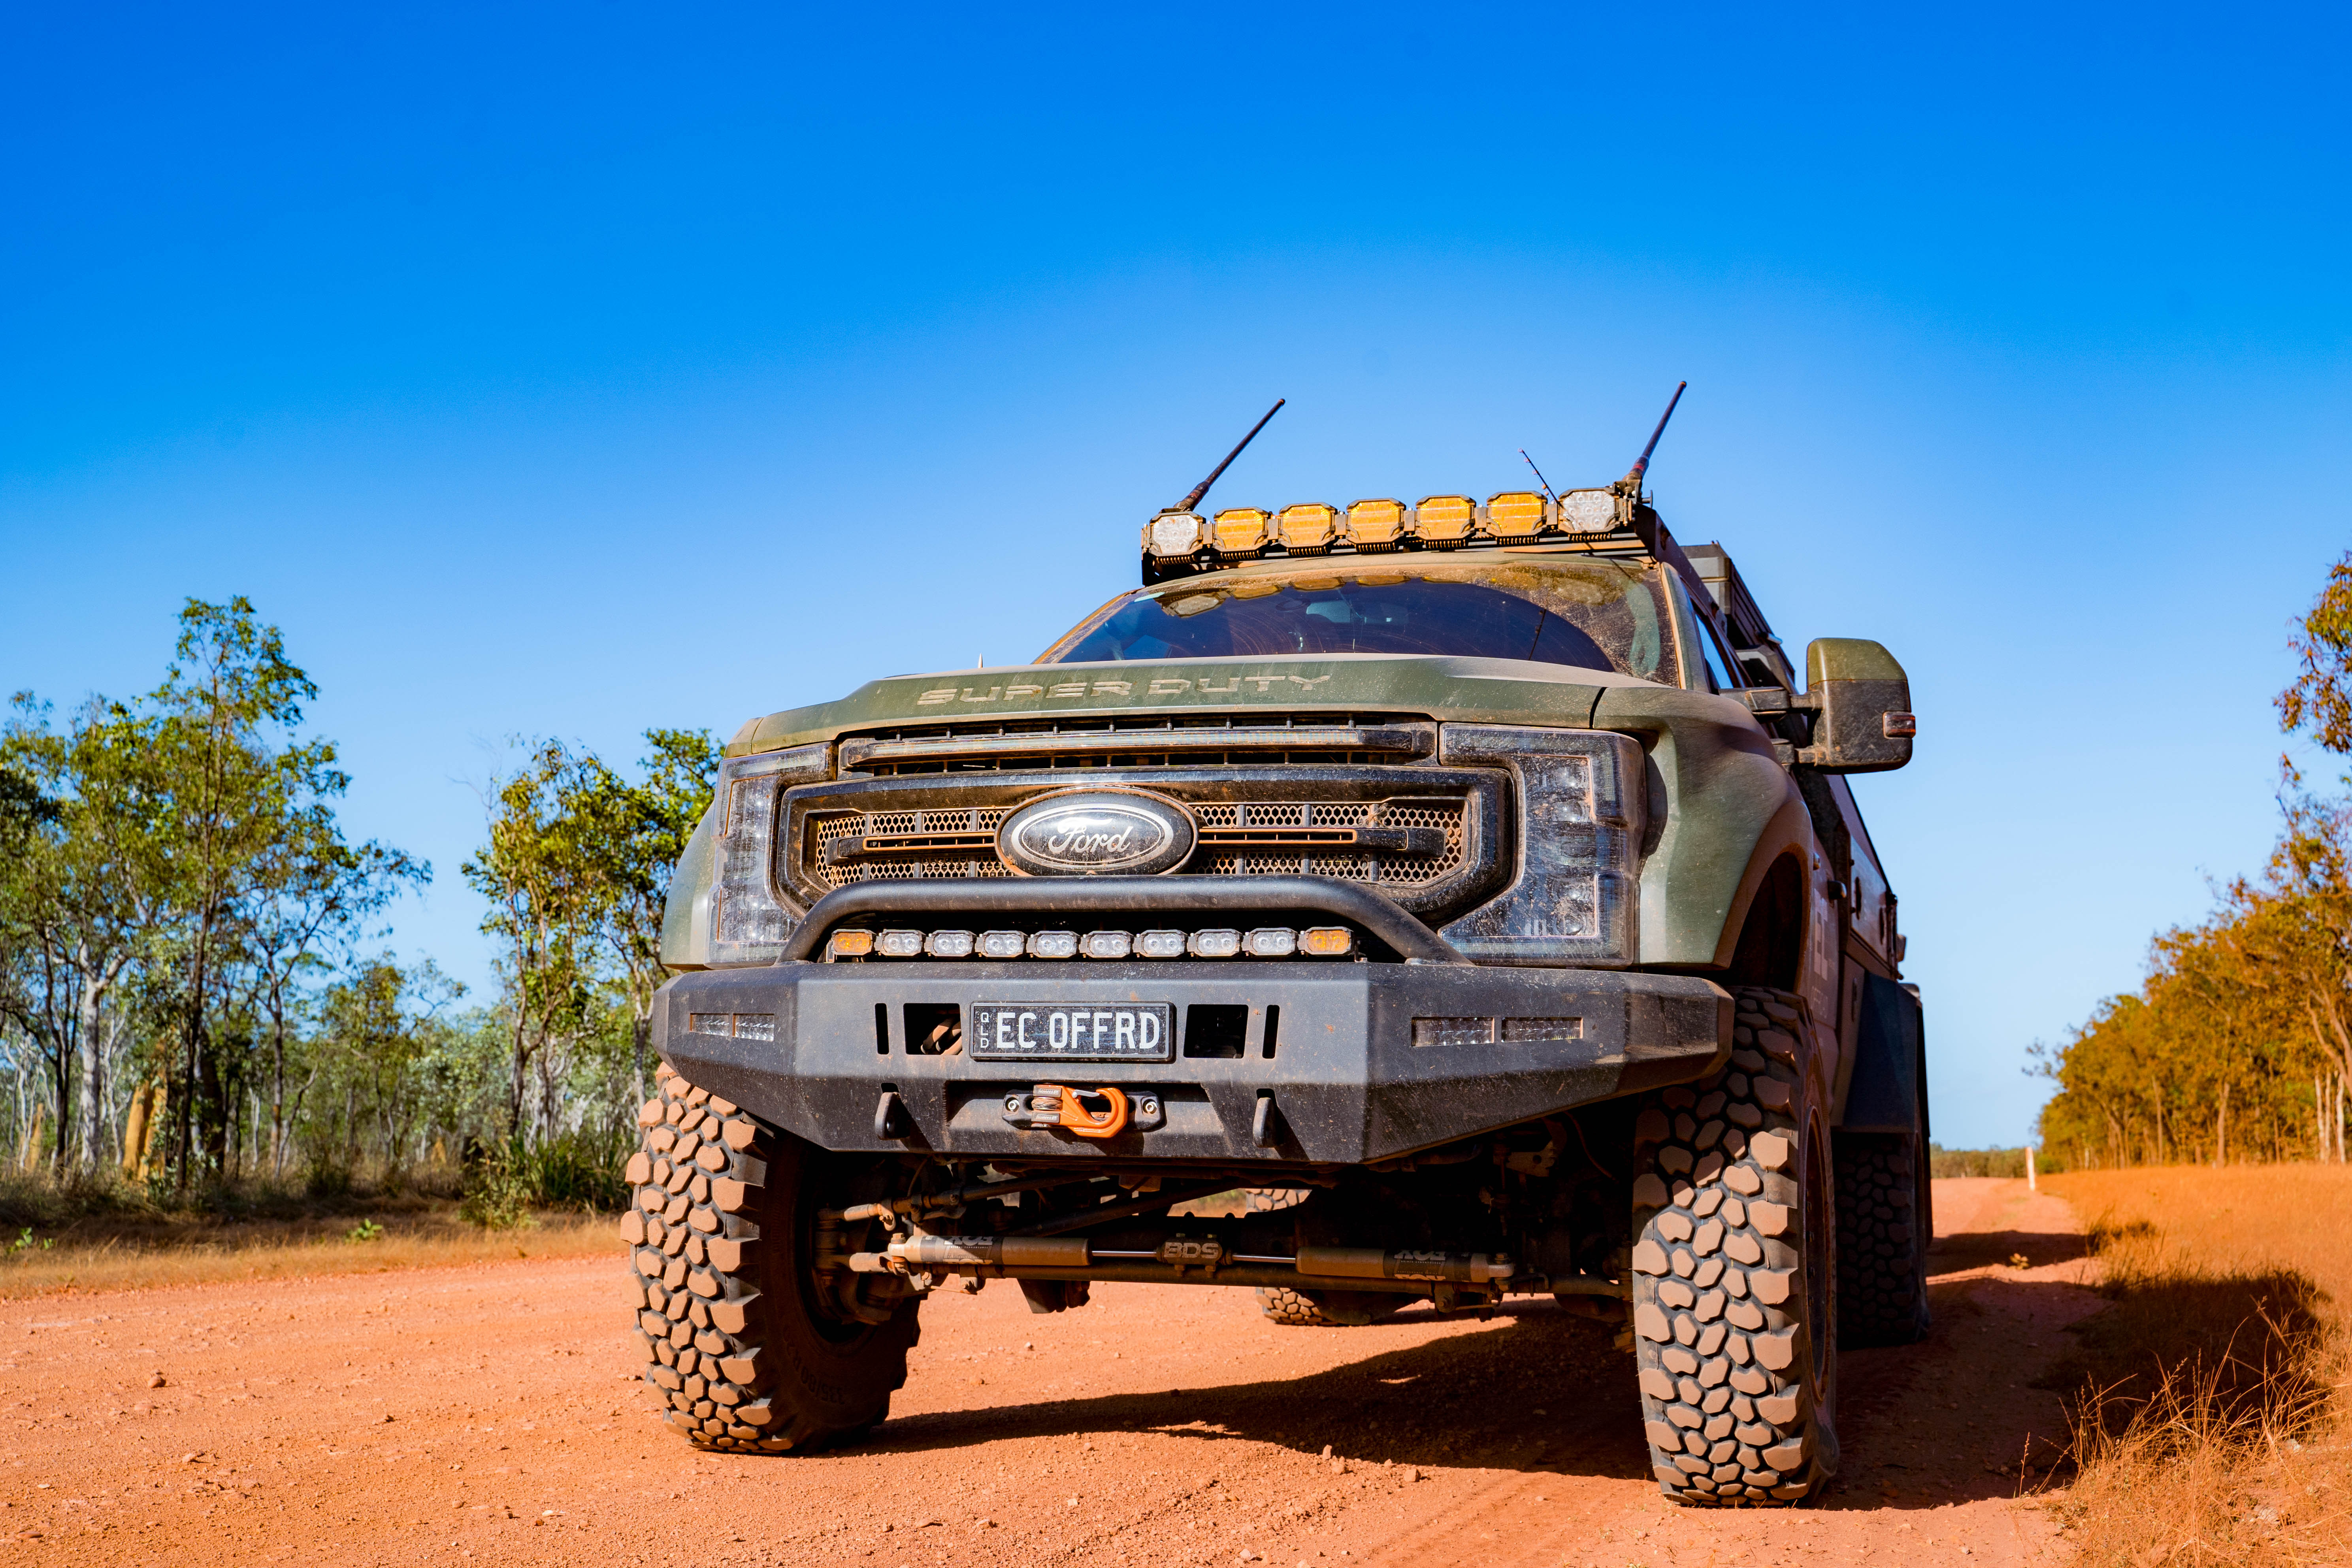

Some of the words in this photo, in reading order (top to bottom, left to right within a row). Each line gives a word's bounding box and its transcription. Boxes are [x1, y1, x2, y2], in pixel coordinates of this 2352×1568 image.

[917, 680, 1133, 705] SUPER
[1148, 675, 1331, 695] DUTY
[1048, 817, 1134, 852] Ford
[980, 1012, 989, 1048] QLD
[997, 1012, 1037, 1048] EC
[1049, 1012, 1160, 1049] OFFRD
[1164, 1242, 1219, 1259] BDS
